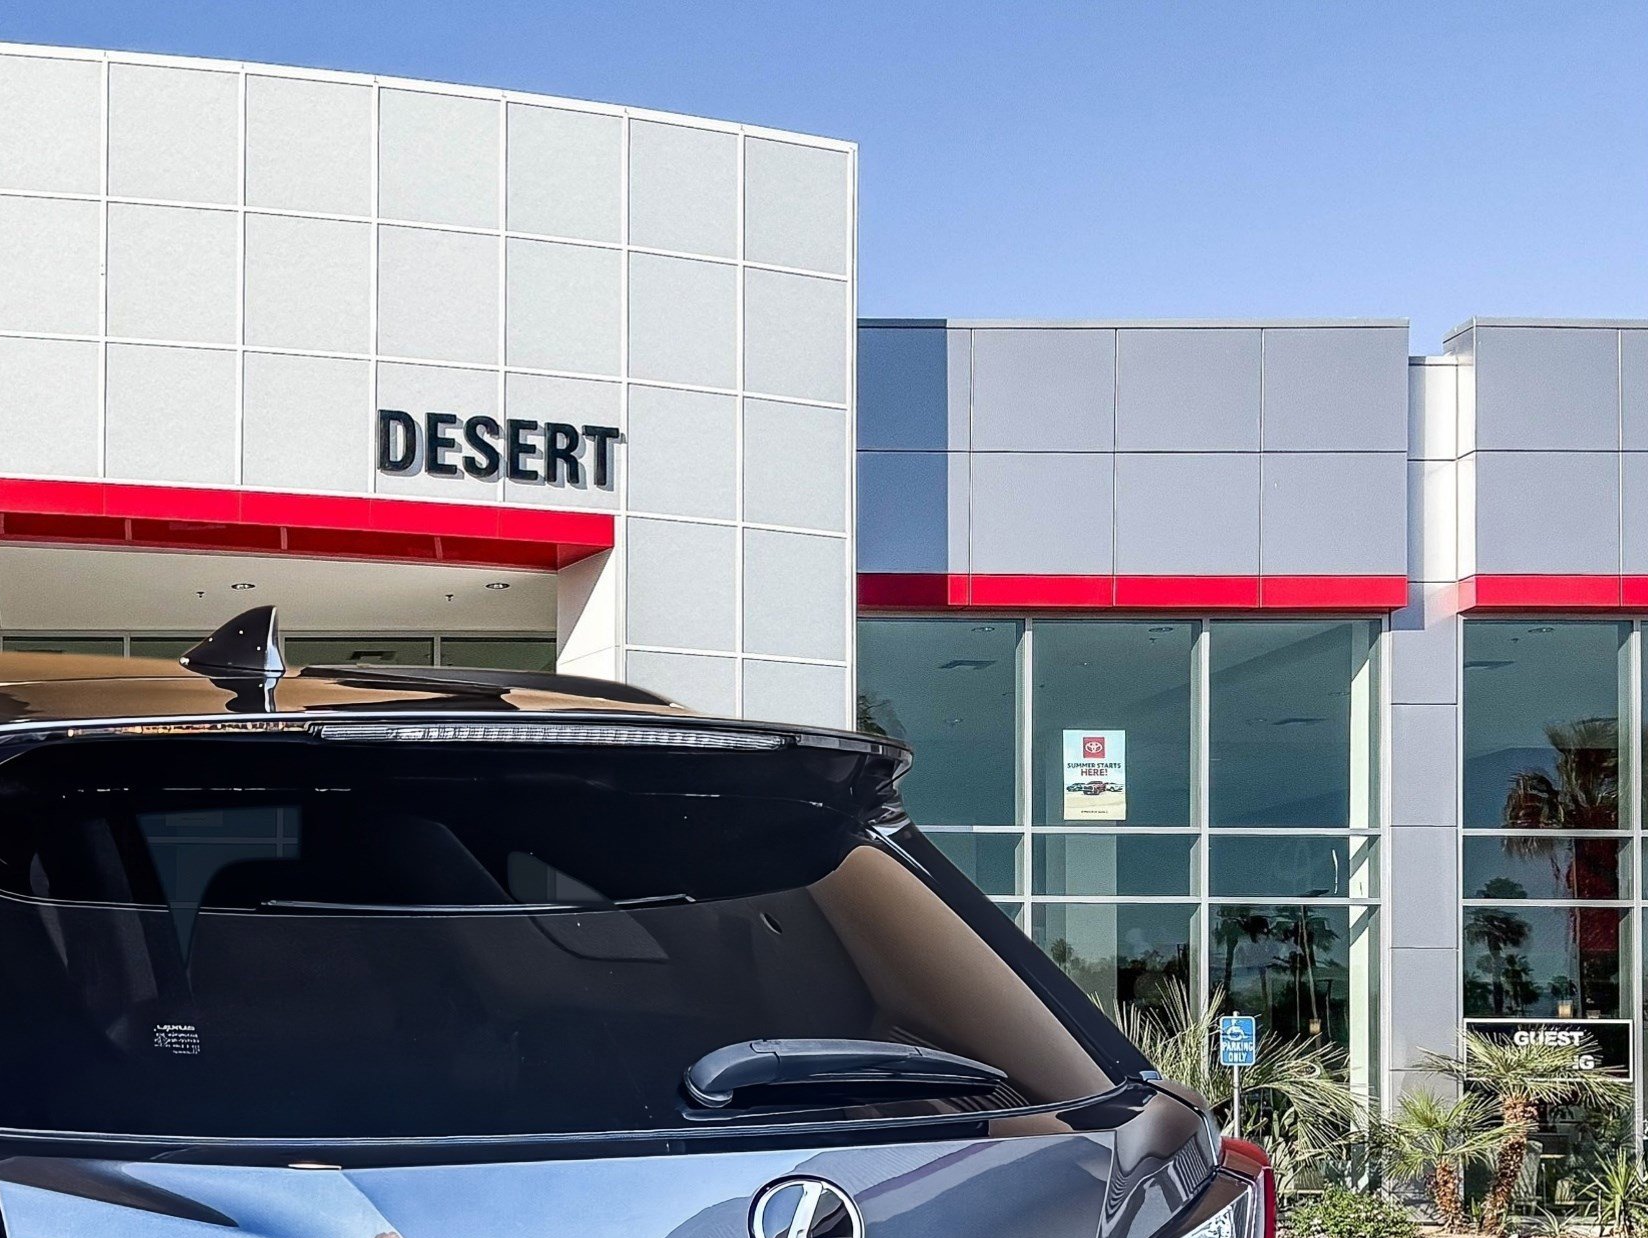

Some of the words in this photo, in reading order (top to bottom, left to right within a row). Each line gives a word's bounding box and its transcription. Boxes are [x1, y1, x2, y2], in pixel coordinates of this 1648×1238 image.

[377, 409, 620, 486] DESERT
[1081, 768, 1108, 776] HERE!
[1514, 1031, 1584, 1046] GUEST
[1222, 1041, 1253, 1051] PARKING
[1228, 1051, 1247, 1062] ONLY
